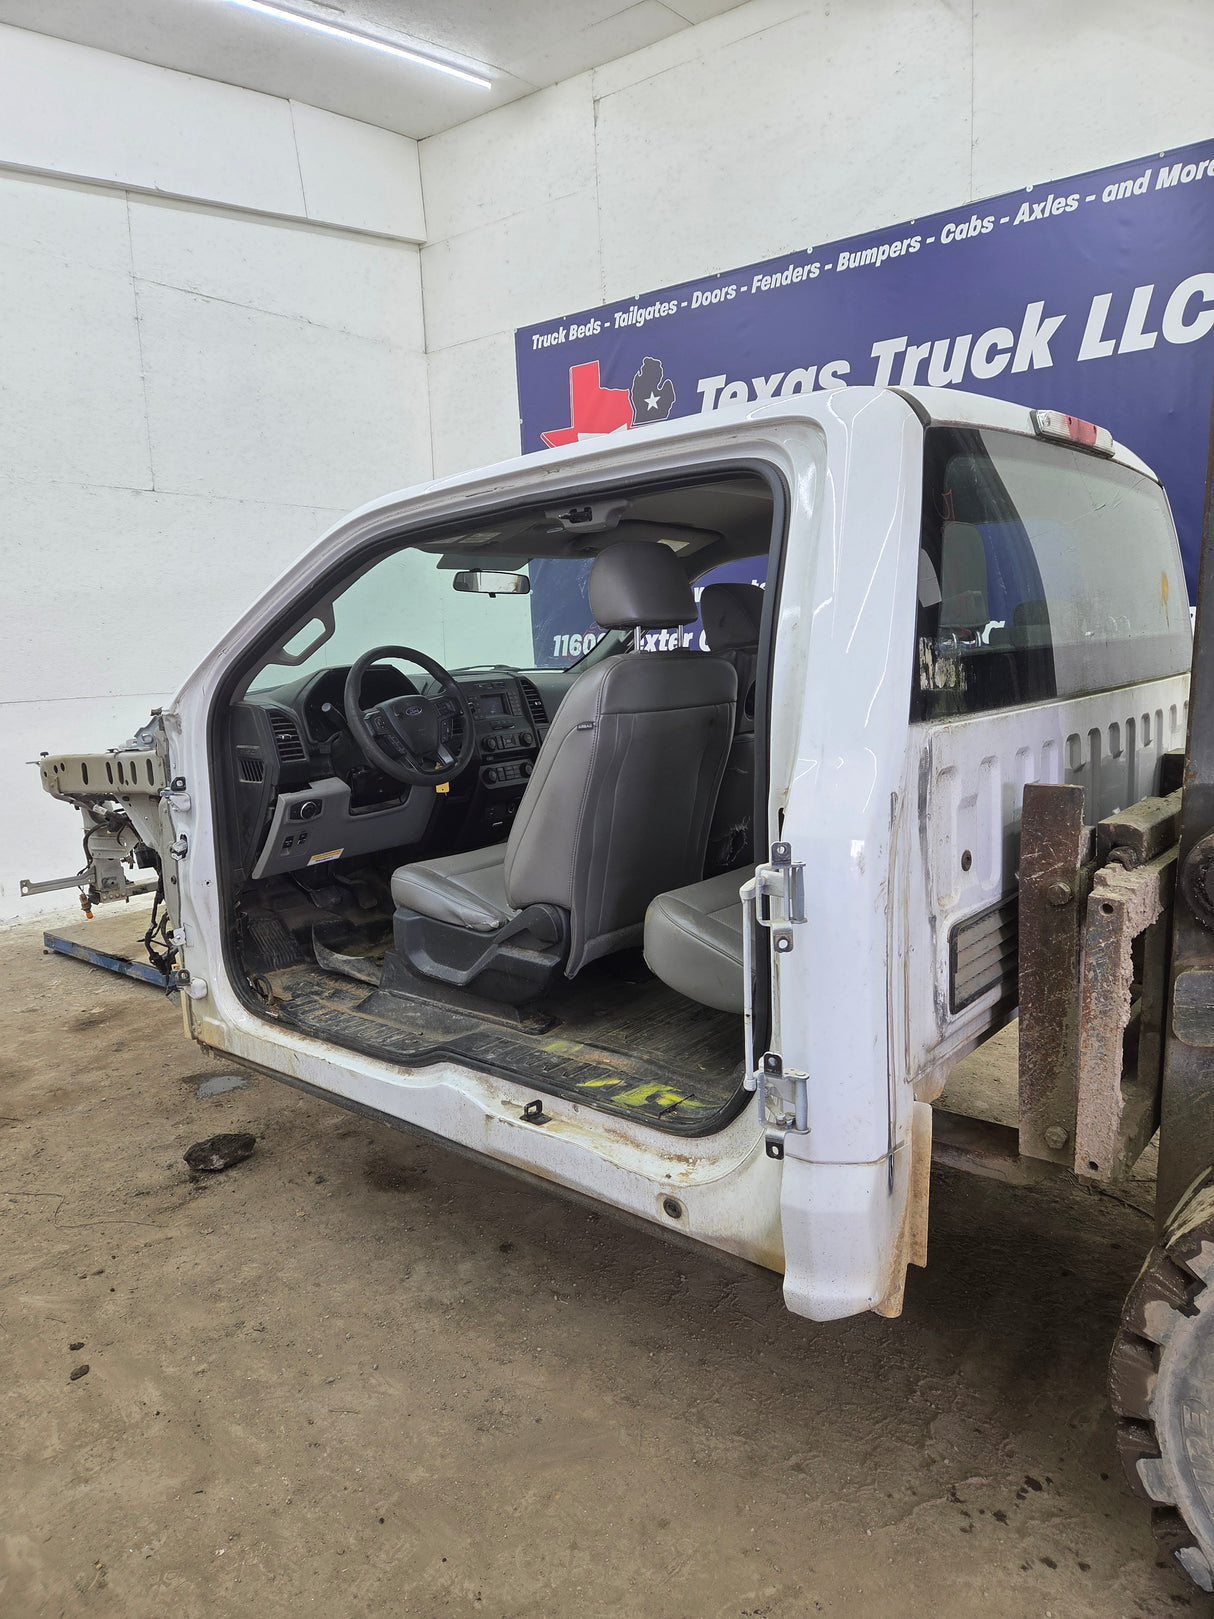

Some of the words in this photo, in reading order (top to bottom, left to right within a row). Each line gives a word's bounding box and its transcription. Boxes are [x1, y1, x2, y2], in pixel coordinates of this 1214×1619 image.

[532, 328, 567, 350] Truck
[569, 318, 602, 341] Beds
[614, 300, 678, 328] Tailgates
[691, 284, 737, 309] Doors
[751, 262, 821, 293] Fenders
[836, 233, 921, 271] Bumpers
[940, 215, 994, 244] Cabs
[1013, 194, 1080, 225] Axles
[1102, 169, 1152, 203] and
[696, 360, 851, 413] Texas
[870, 300, 1067, 387] Truck
[1077, 272, 1214, 362] LLC
